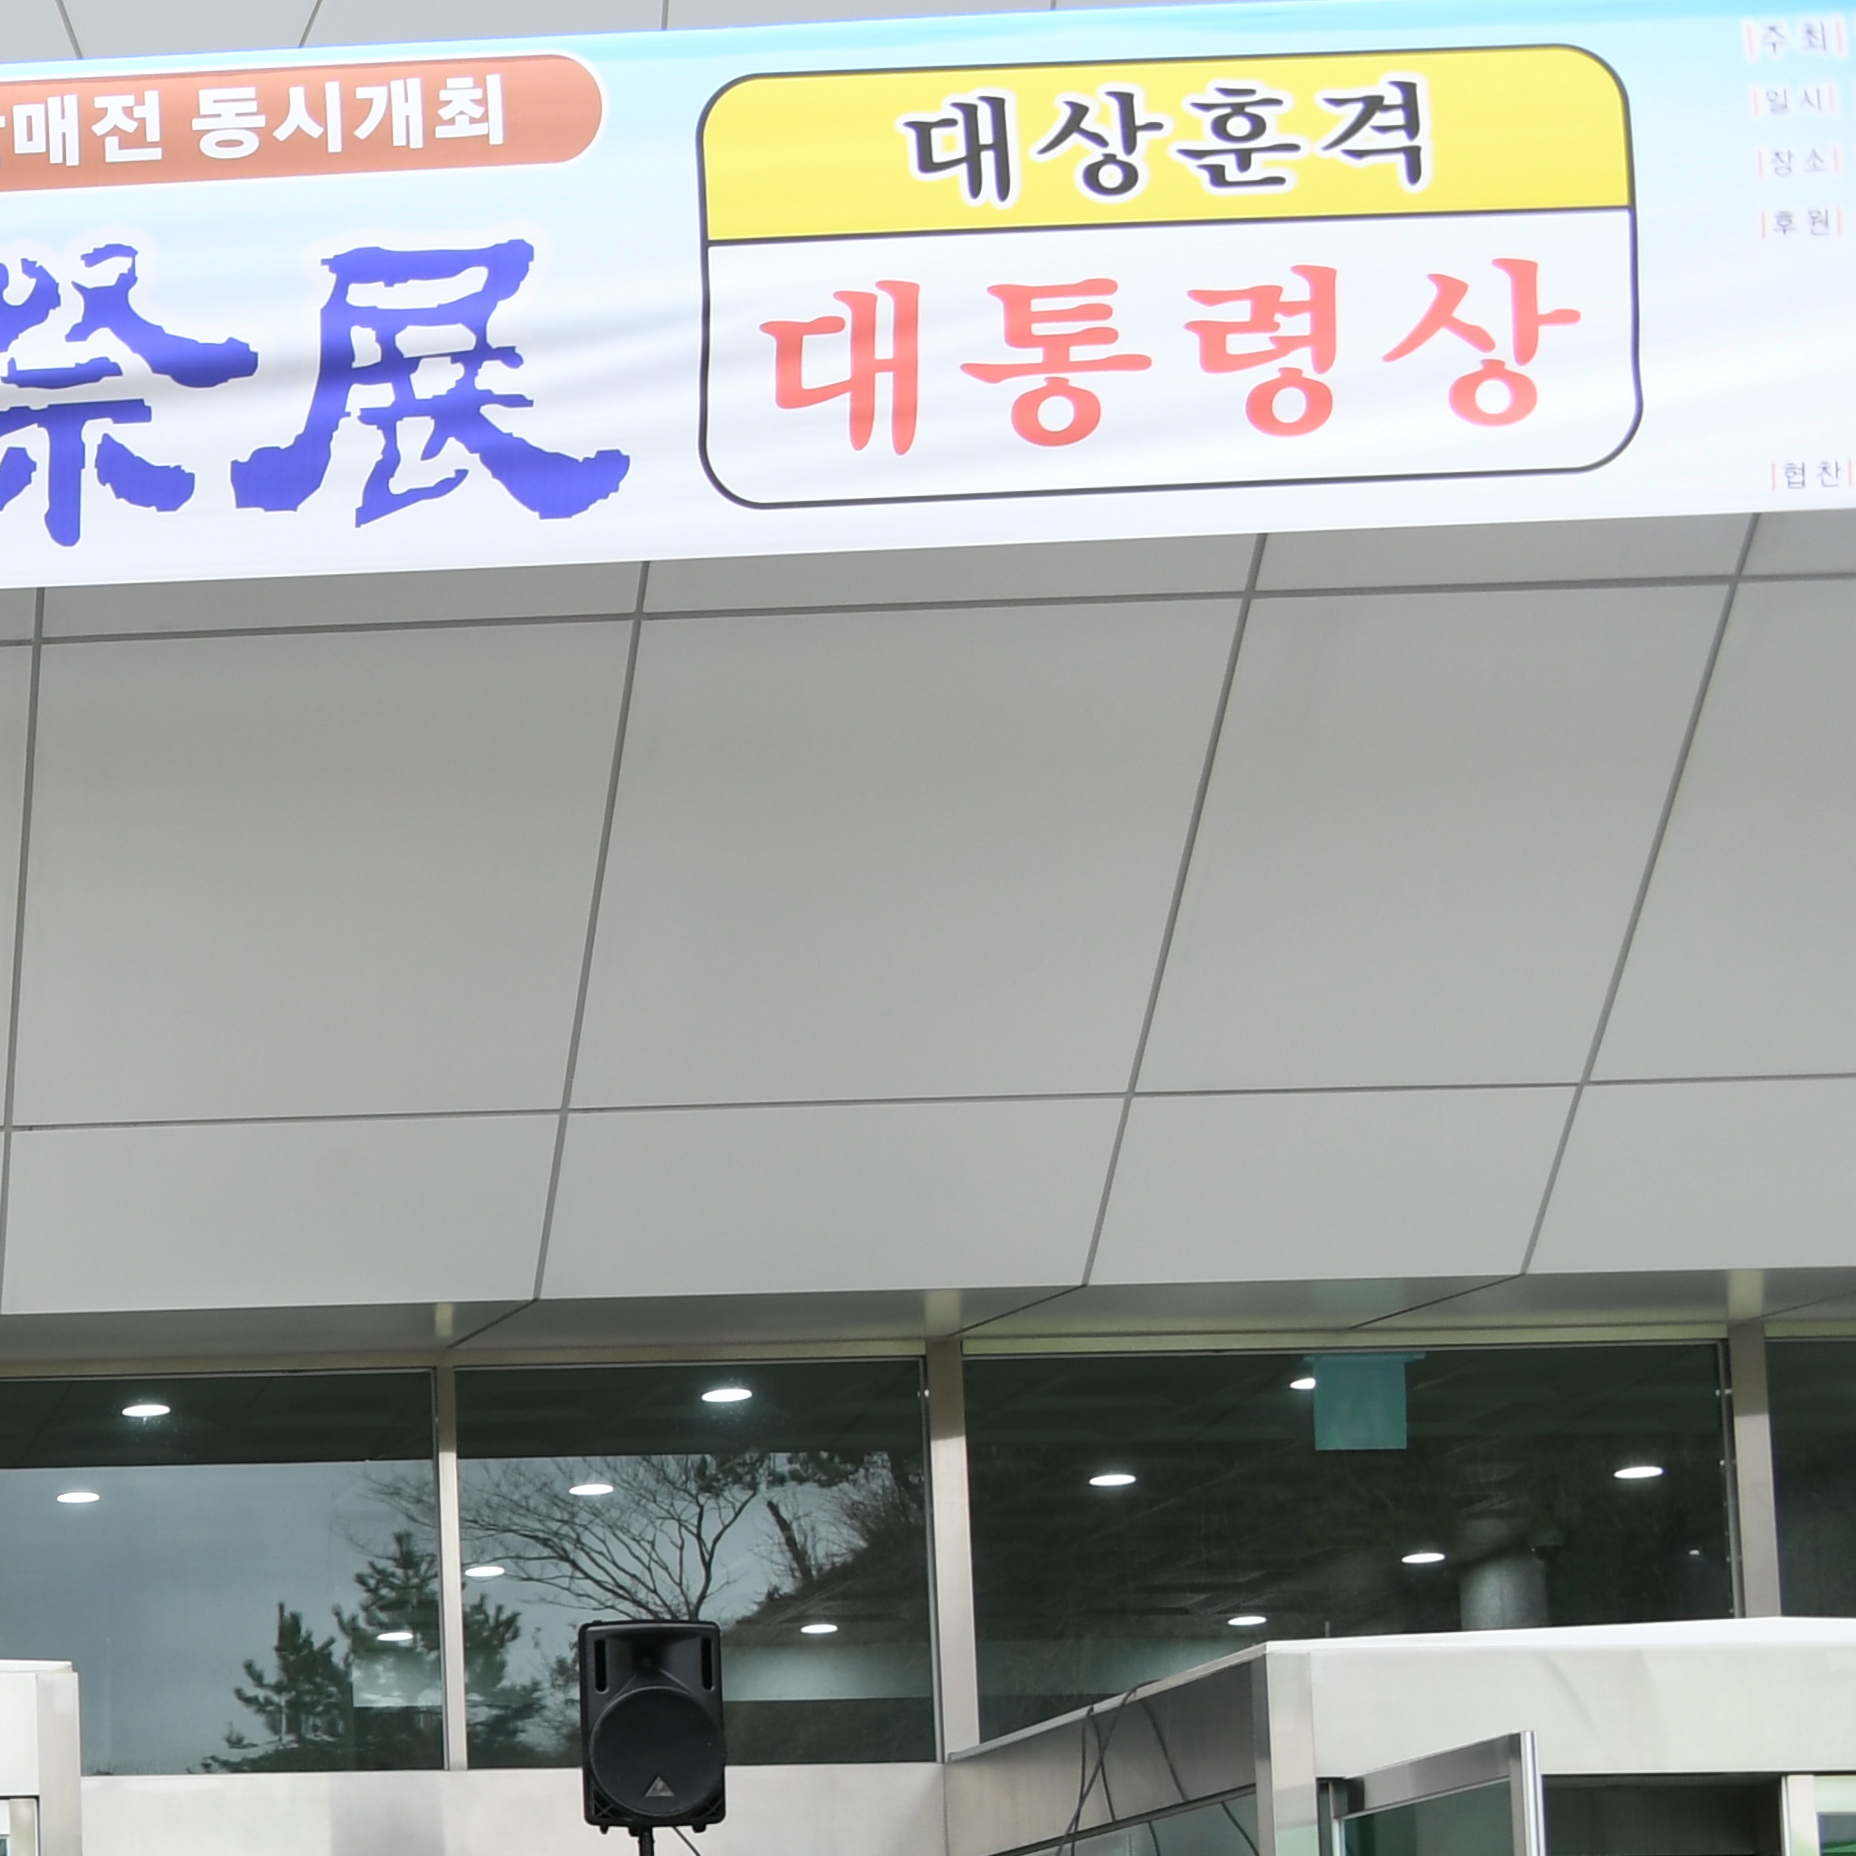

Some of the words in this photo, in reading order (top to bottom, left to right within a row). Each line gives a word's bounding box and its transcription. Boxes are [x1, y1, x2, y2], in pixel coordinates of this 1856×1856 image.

[190, 70, 507, 162] 동시개최
[903, 82, 1426, 201] 대상훈격
[761, 257, 1583, 455] 대통령상
